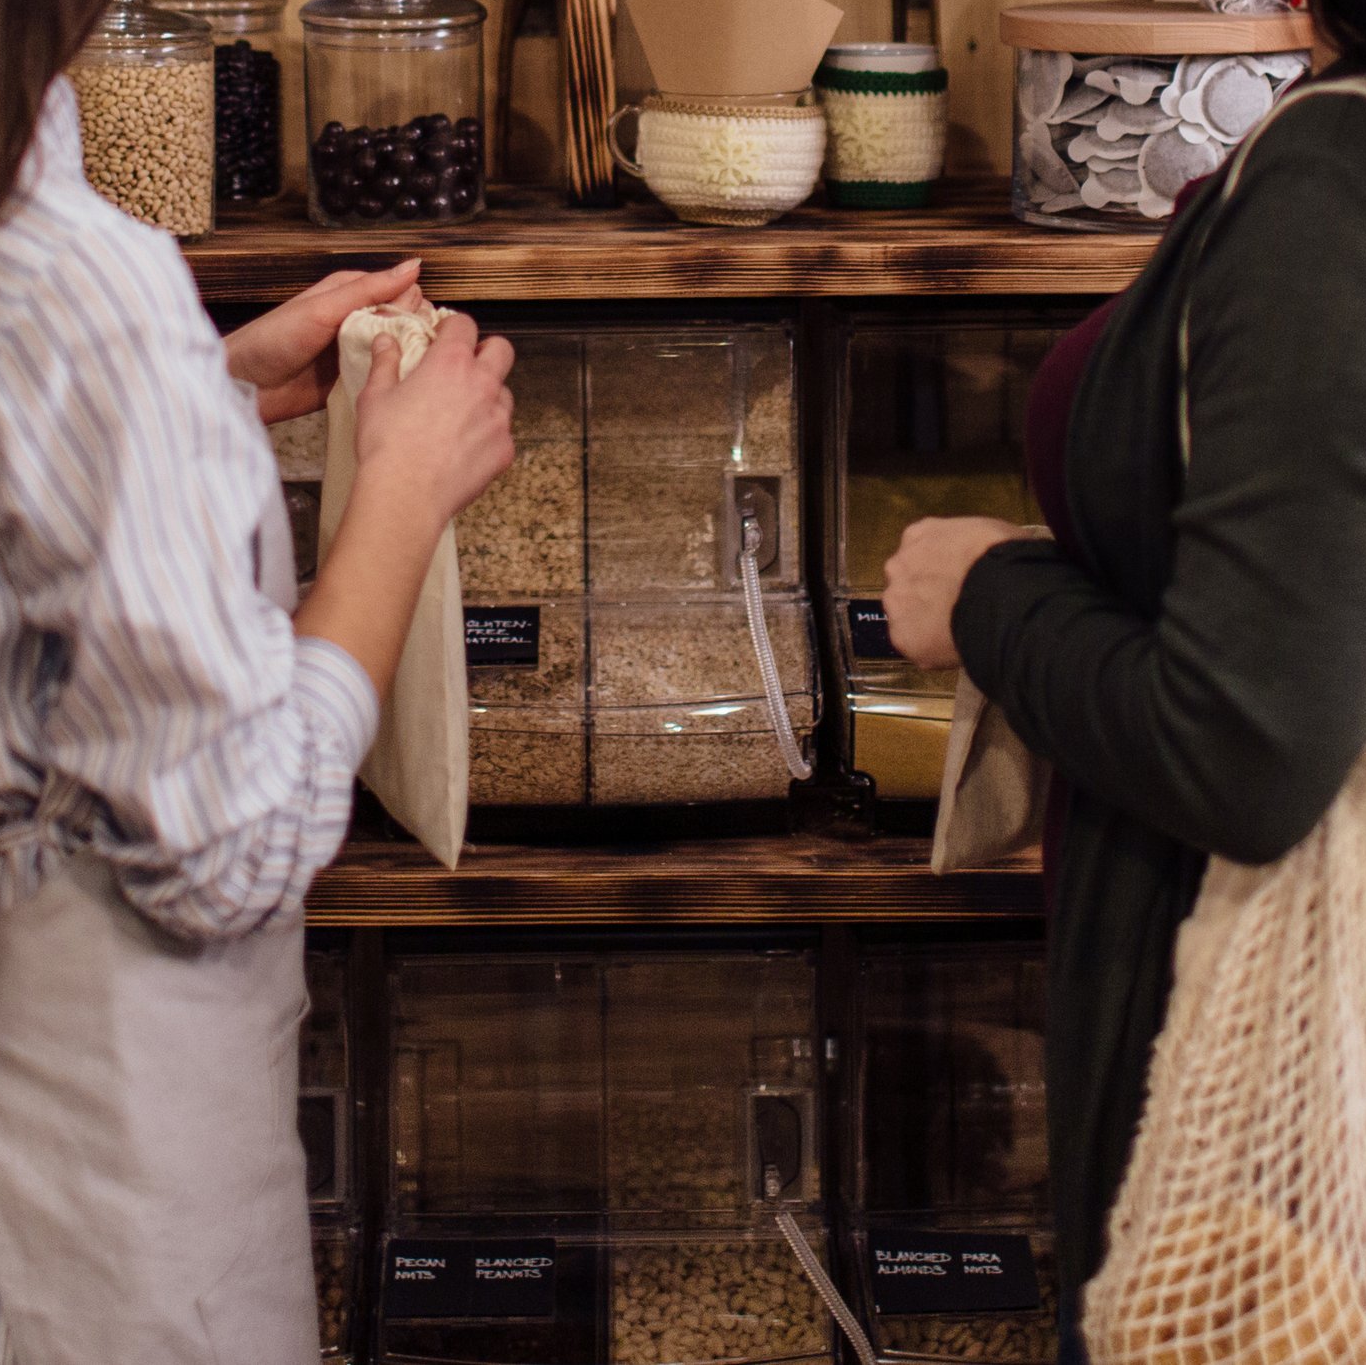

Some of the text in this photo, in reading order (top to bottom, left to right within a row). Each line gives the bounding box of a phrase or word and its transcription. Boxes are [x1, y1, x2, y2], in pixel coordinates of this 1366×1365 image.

[395, 1256, 446, 1268] PECAN
[961, 1253, 1002, 1263] PARA
[475, 1269, 542, 1279] PEANUTS
